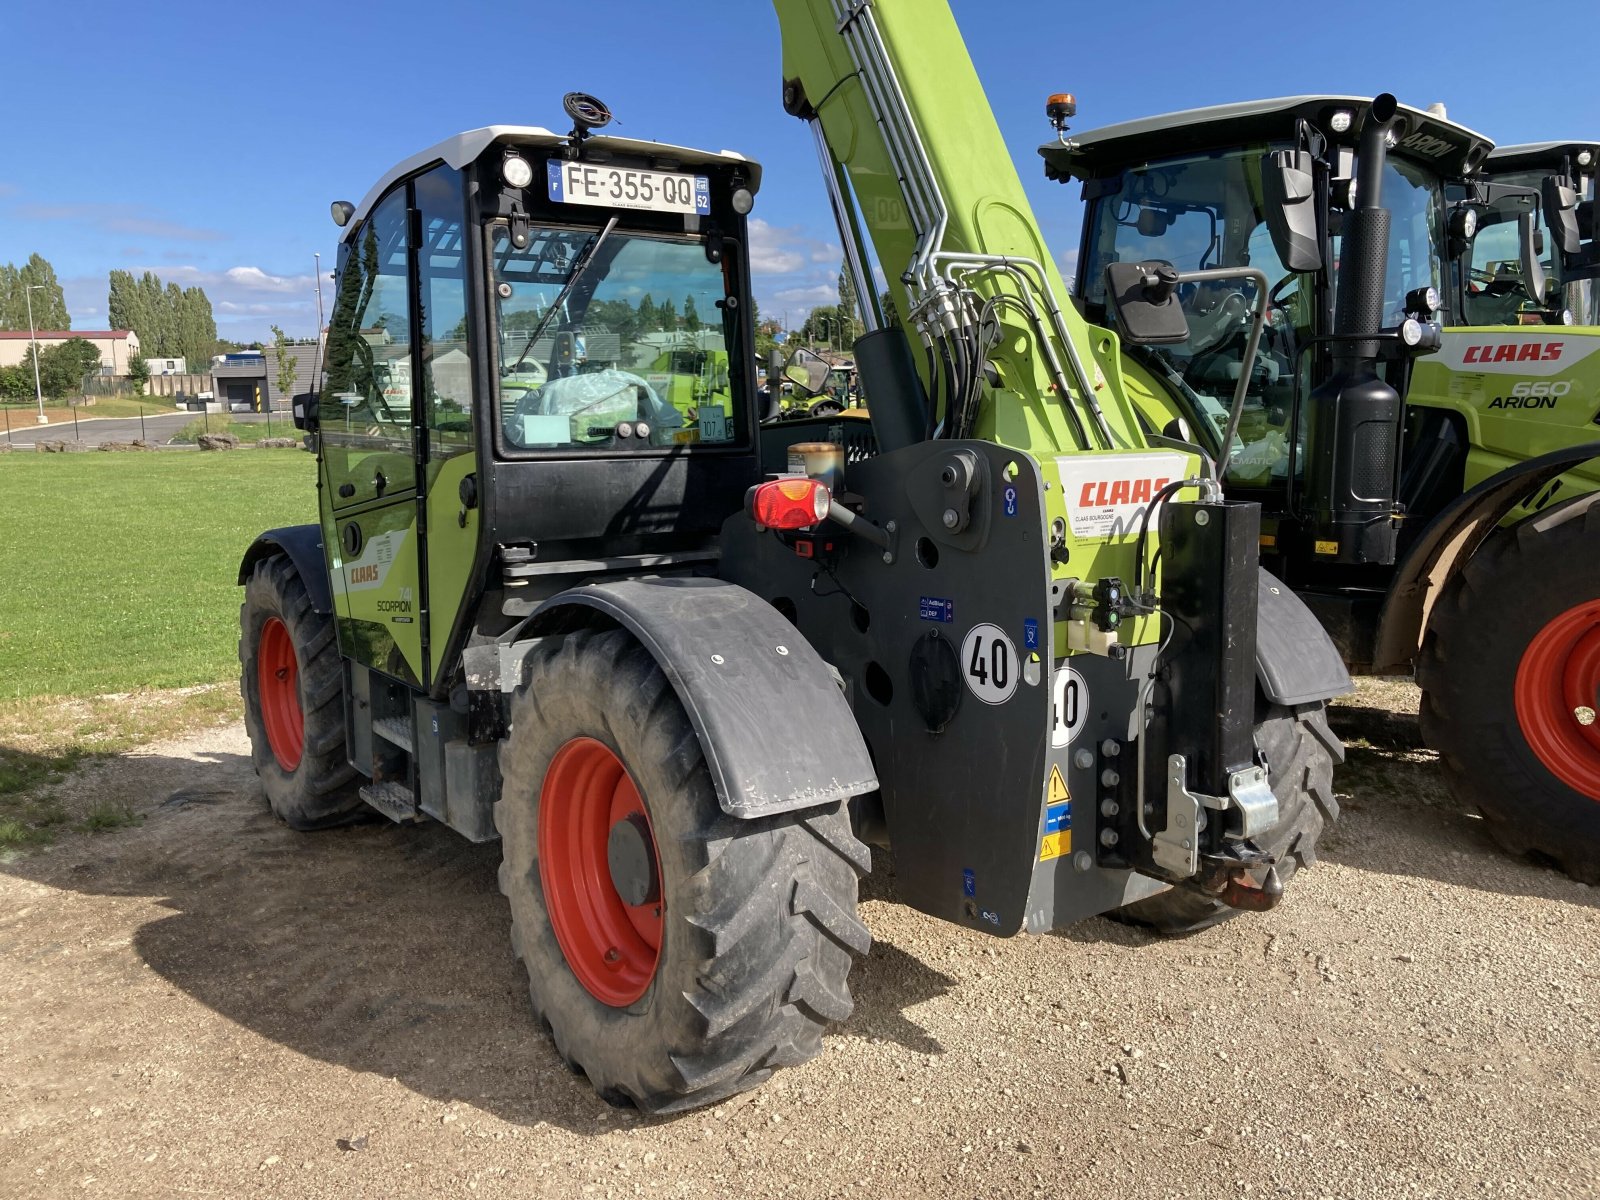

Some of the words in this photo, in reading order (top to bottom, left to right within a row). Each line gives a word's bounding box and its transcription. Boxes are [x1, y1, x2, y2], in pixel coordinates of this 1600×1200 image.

[1402, 132, 1458, 157] ARION
[552, 182, 558, 191] F
[567, 166, 691, 205] FE-355-QQ
[697, 195, 708, 208] 52
[1463, 343, 1564, 364] CLAAS
[1512, 381, 1571, 396] 660
[1488, 397, 1557, 409] ARION
[1231, 457, 1273, 466] CMATIC
[351, 564, 378, 584] CLAAS
[377, 600, 411, 613] SCORPION
[970, 636, 1007, 689] 40
